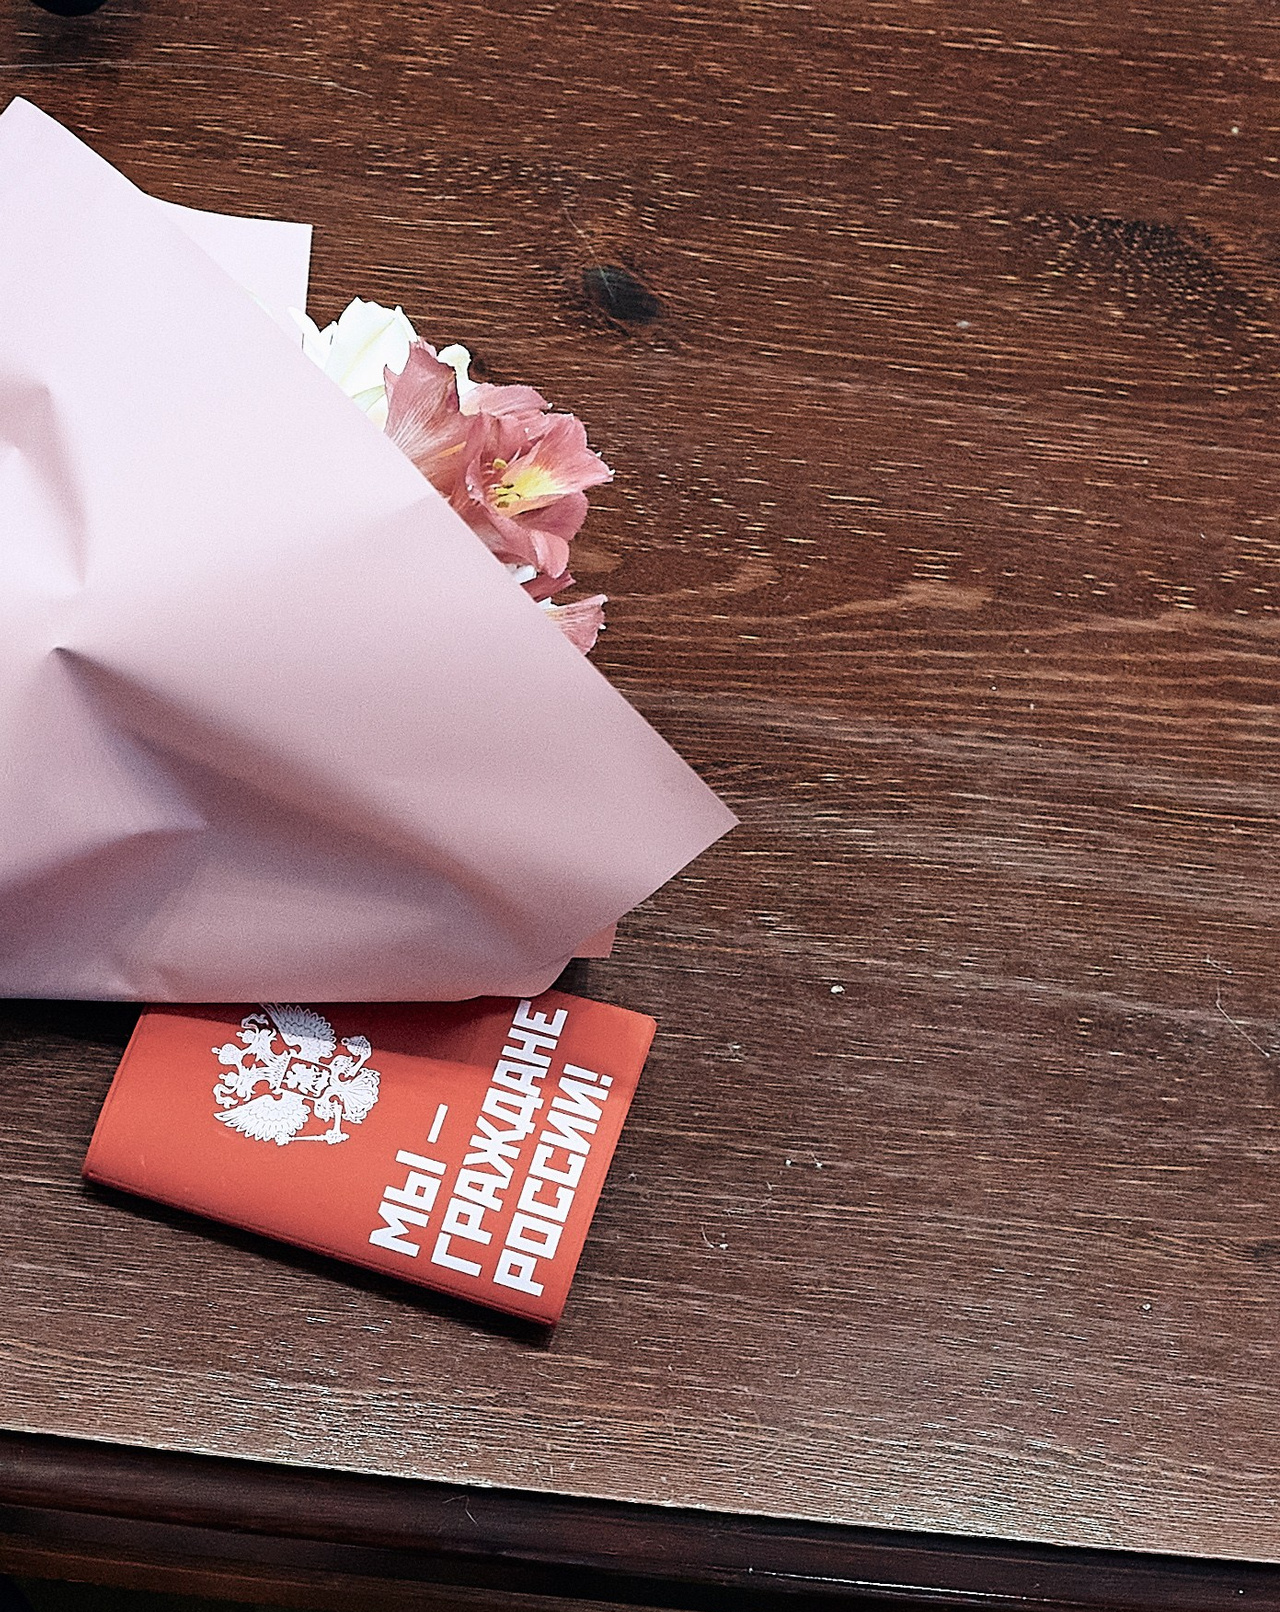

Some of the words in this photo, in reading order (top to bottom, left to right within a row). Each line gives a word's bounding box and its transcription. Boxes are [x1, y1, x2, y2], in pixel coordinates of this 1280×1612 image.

[369, 1149, 447, 1257] МЫ
[431, 1000, 568, 1277] ГРАЖДАНЕ
[493, 1063, 613, 1297] РОССИИ!
